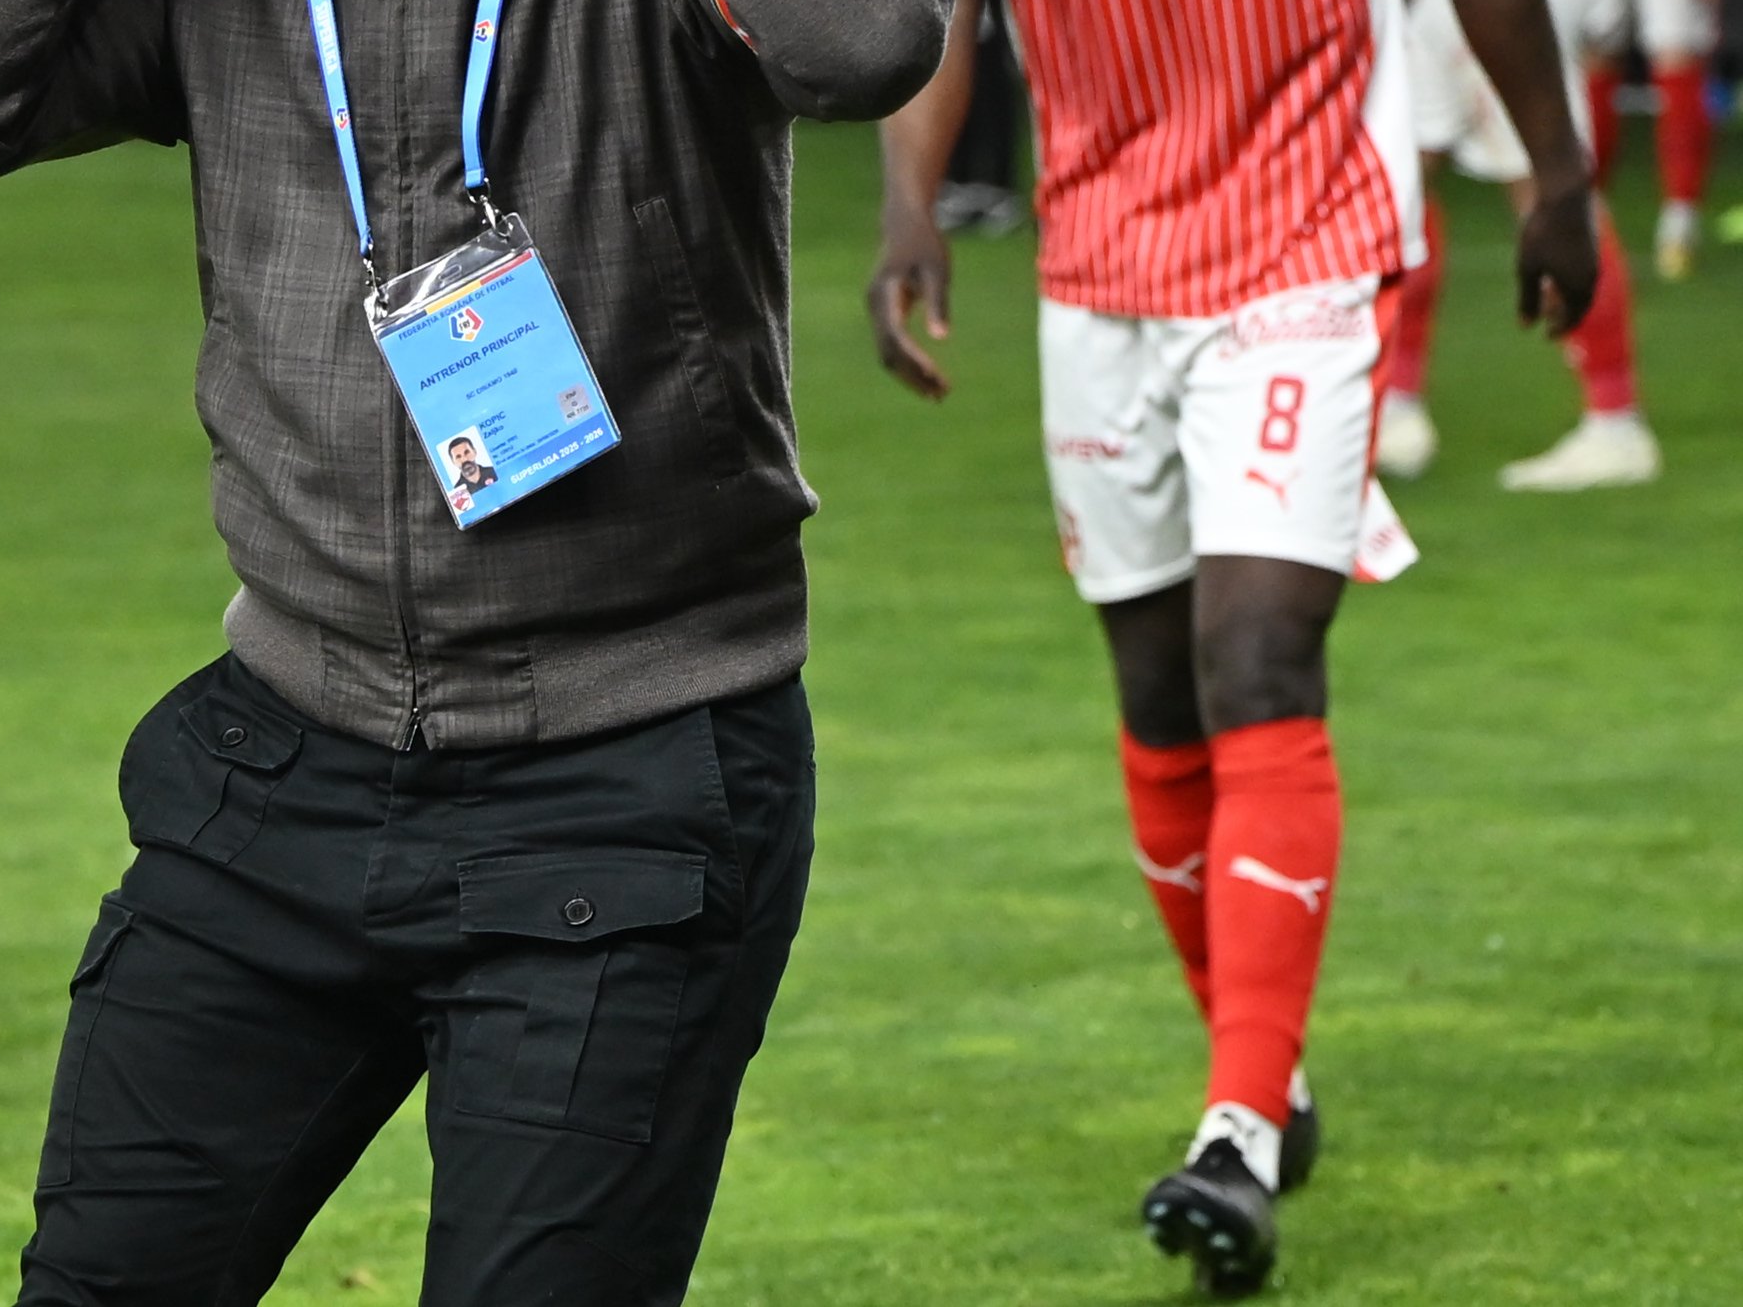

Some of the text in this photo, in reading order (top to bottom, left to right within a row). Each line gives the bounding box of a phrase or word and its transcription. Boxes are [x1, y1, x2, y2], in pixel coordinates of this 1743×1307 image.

[315, 0, 338, 75] SUPERLIGA
[475, 289, 486, 300] DE
[487, 274, 515, 294] FOTBAL
[420, 321, 540, 391] ANTRENOR PRINCIPAL
[1260, 375, 1305, 453] 8
[510, 453, 560, 484] SUPERLIGA
[559, 441, 579, 458] 2025
[584, 427, 604, 444] 2026
